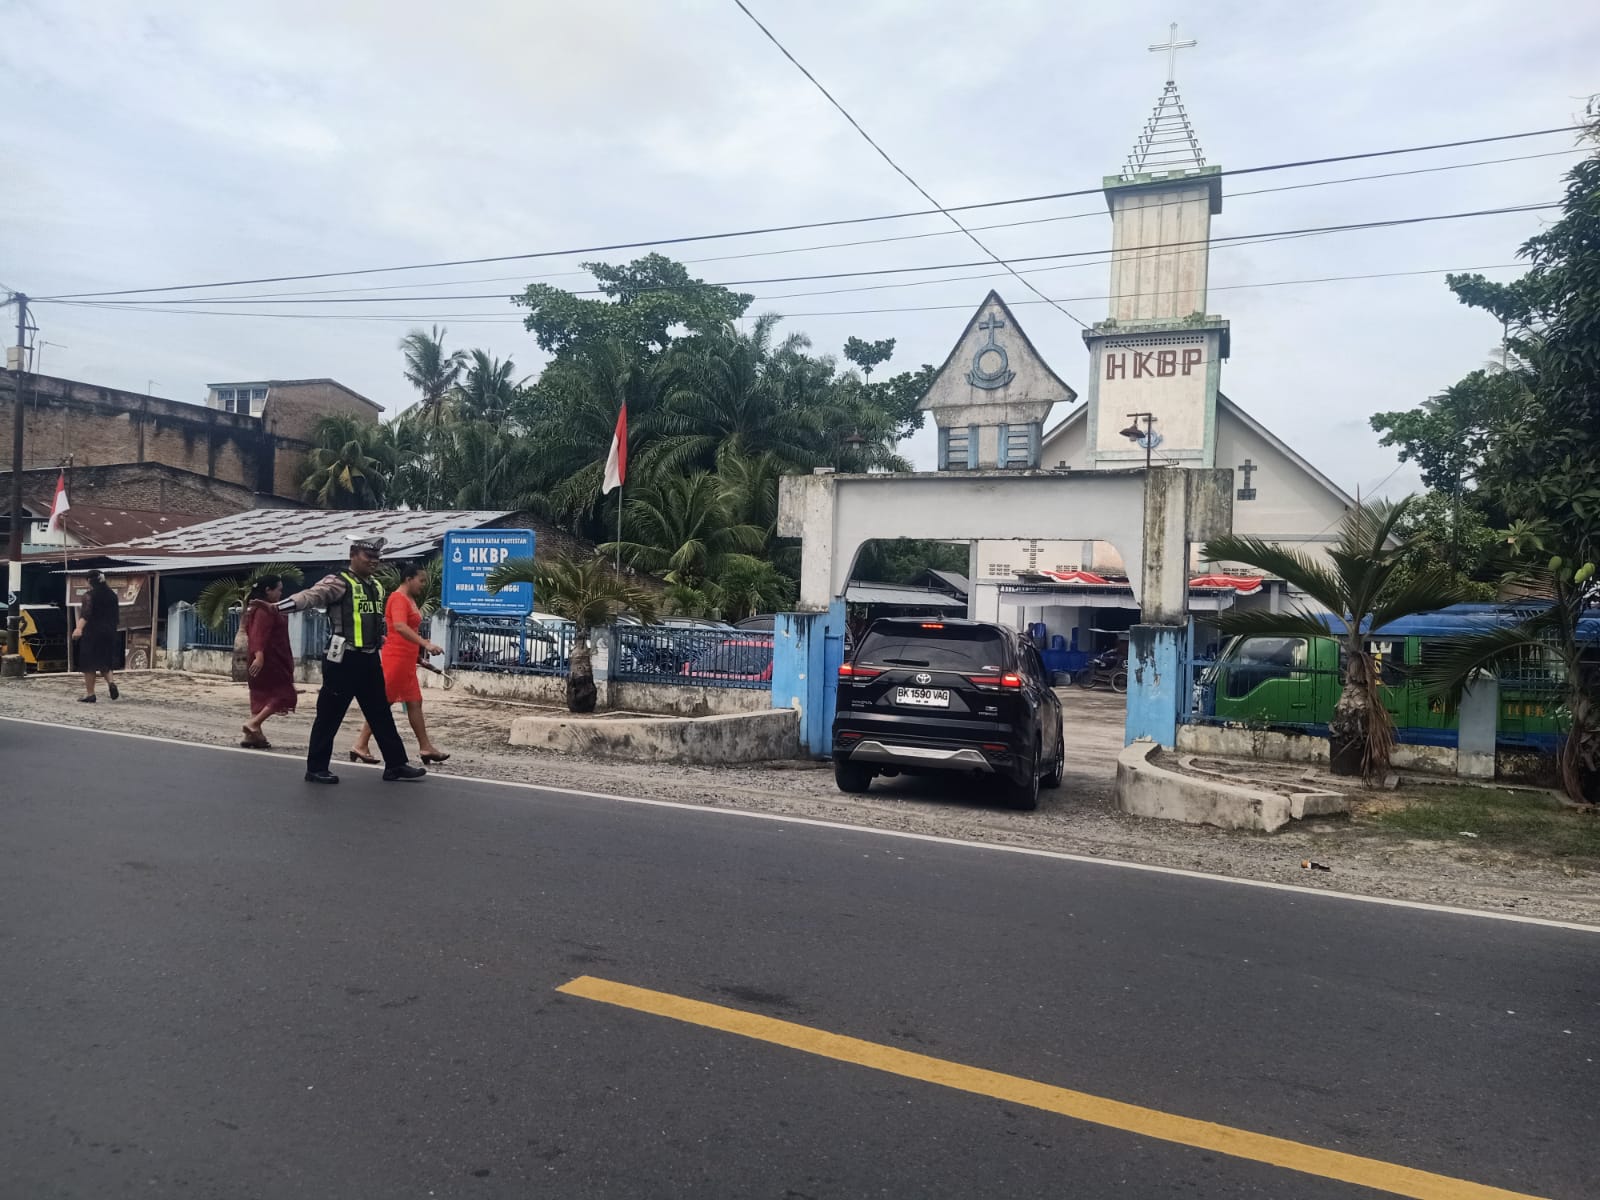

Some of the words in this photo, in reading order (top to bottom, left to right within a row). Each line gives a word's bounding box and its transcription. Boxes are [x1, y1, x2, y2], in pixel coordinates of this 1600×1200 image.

[1106, 348, 1203, 381] HKBP
[469, 547, 509, 564] HKBP
[898, 688, 910, 698] BK
[911, 689, 931, 699] 1590
[933, 690, 948, 701] VAG
